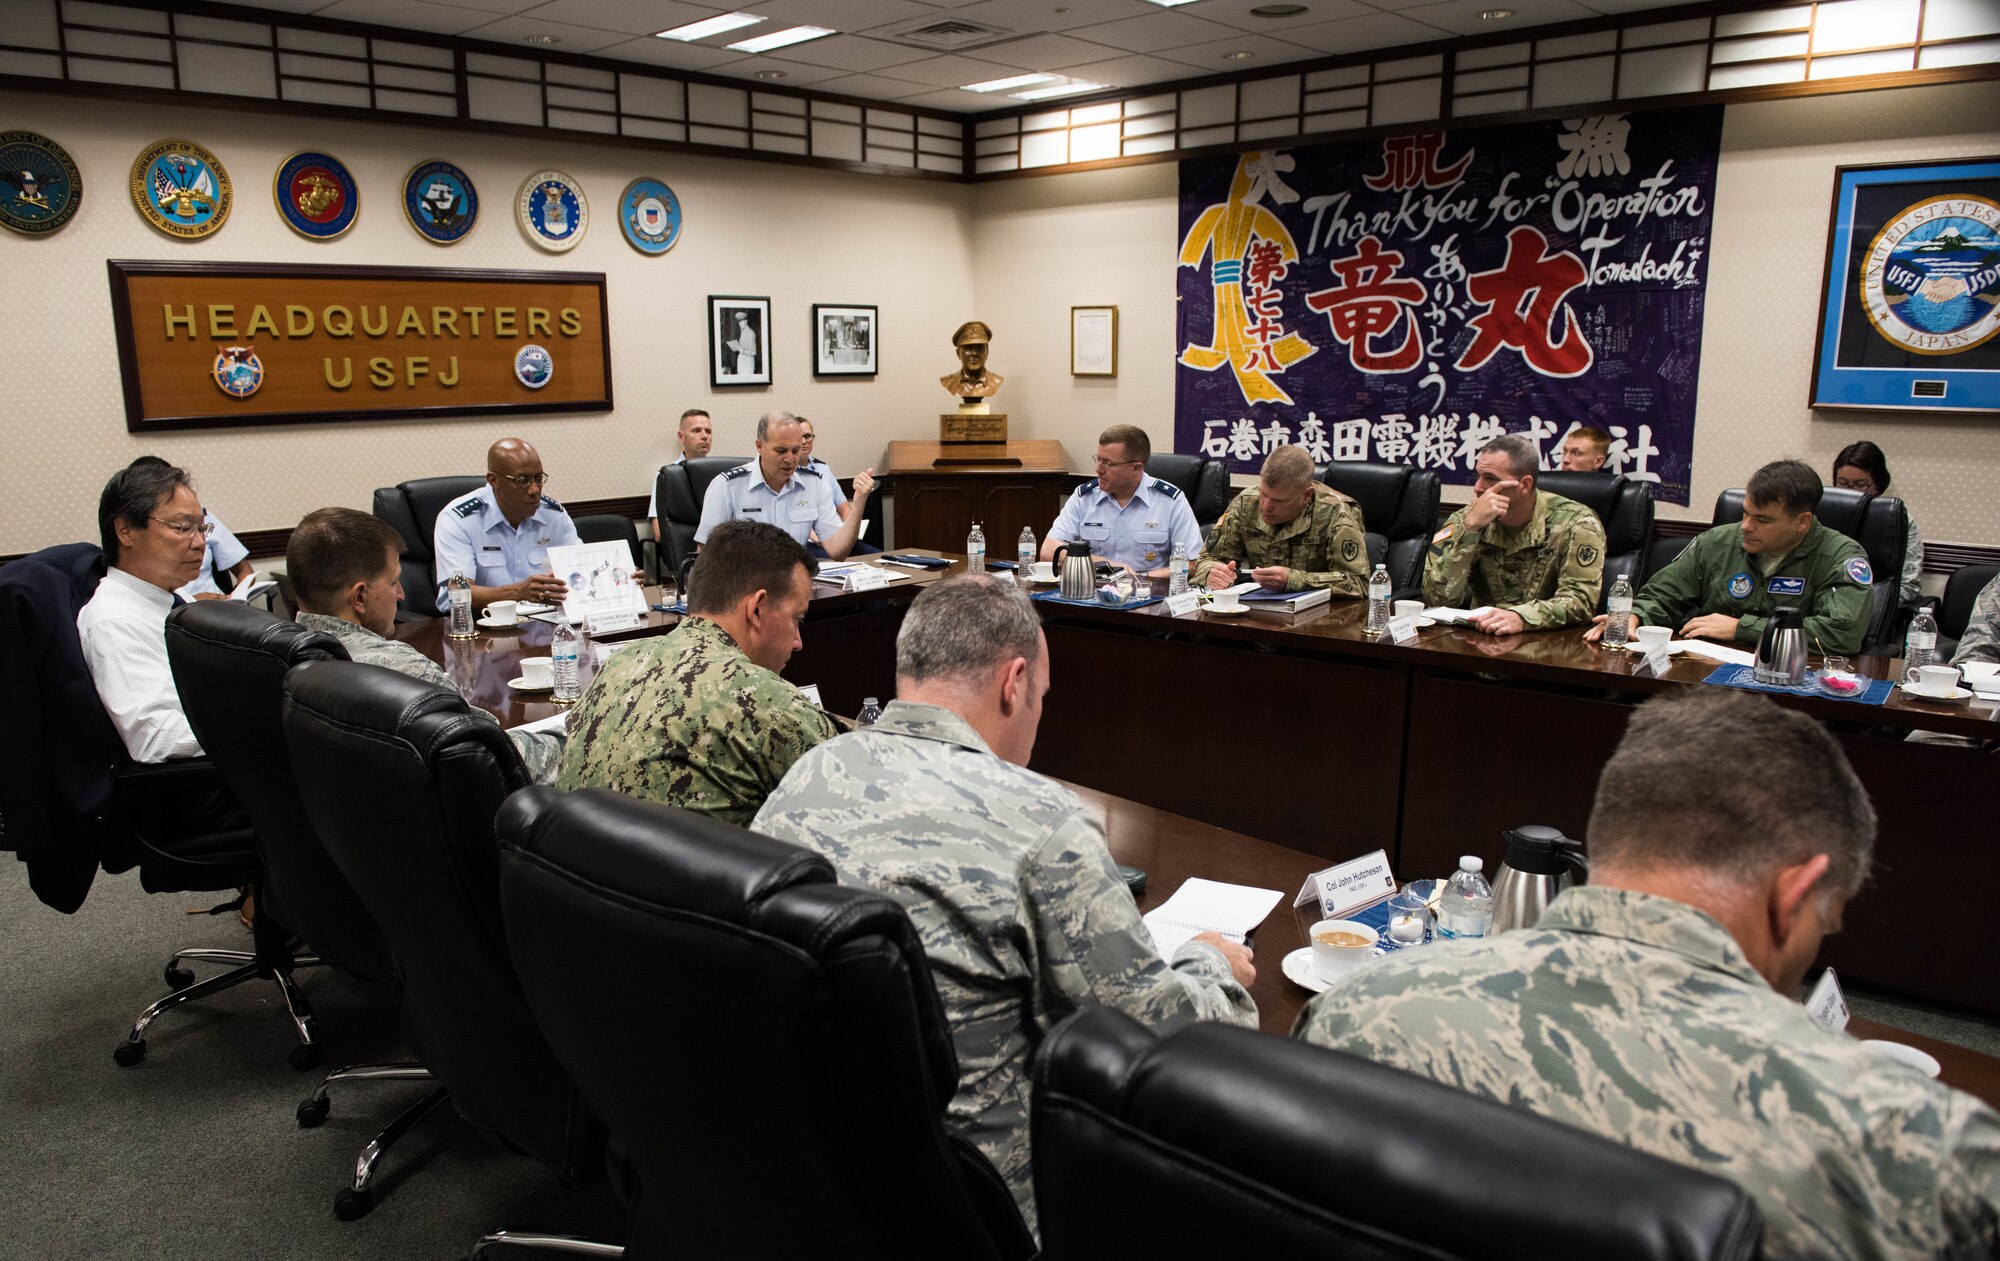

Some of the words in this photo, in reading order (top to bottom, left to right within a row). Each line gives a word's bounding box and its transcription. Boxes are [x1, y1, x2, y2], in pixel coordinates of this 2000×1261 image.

[138, 143, 177, 180] DEPARTMENT
[179, 143, 192, 152] OF
[194, 147, 210, 162] THE
[209, 161, 227, 184] ARMY
[138, 190, 160, 221] UNITED
[162, 221, 194, 234] STATES
[198, 224, 209, 234] OF
[1302, 190, 1419, 255] Thank
[1405, 180, 1478, 242] You
[1478, 172, 1550, 232] for
[1867, 221, 1910, 290] UNITED
[1913, 201, 1994, 223] STATES
[1887, 264, 1921, 291] USFJ
[163, 303, 583, 338] HEADQUARTERS
[1244, 238, 1287, 373] 第七十八
[1418, 233, 1471, 414] ありがとう
[1905, 331, 1970, 349] JAPAN
[323, 355, 461, 389] USFJ
[1326, 881, 1337, 891] Col
[1338, 876, 1353, 888] John
[1352, 865, 1384, 882] Hutcheson
